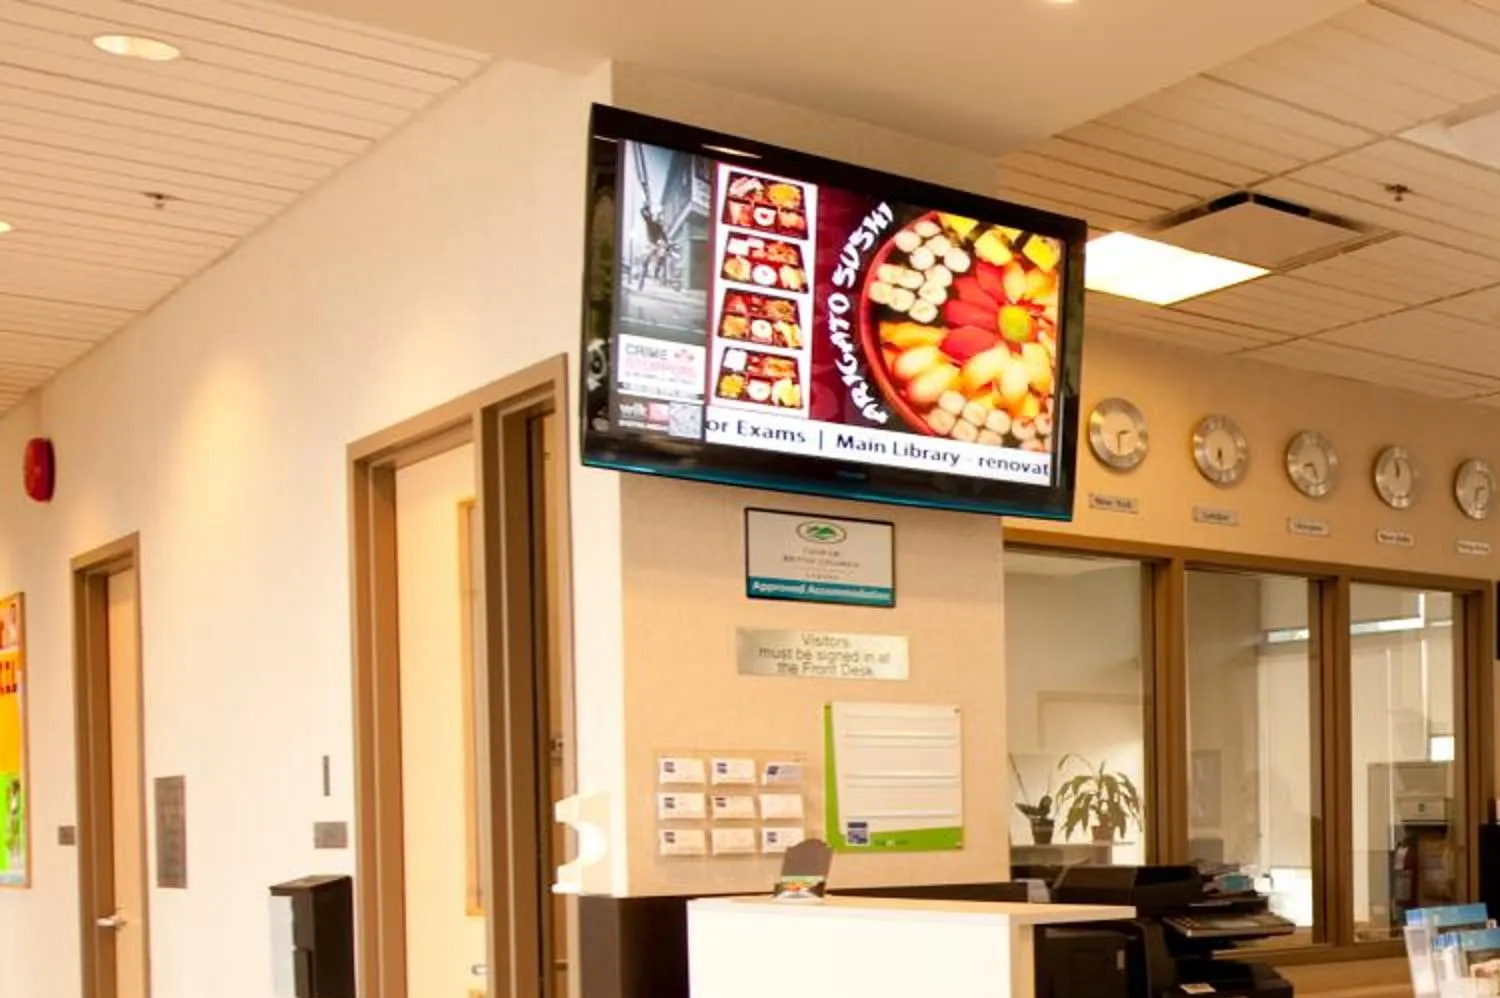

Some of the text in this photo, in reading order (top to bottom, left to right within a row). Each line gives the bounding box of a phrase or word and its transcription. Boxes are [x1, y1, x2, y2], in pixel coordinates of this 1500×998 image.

[831, 201, 894, 289] SUSHI
[827, 292, 889, 425] ARIGATO
[737, 420, 807, 444] Exams
[836, 433, 887, 456] Main
[893, 441, 962, 467] Library
[977, 456, 1050, 478] renovat
[759, 647, 891, 665] must be signed in at
[800, 633, 850, 648] Visitors
[777, 662, 874, 677] the Front Desk
